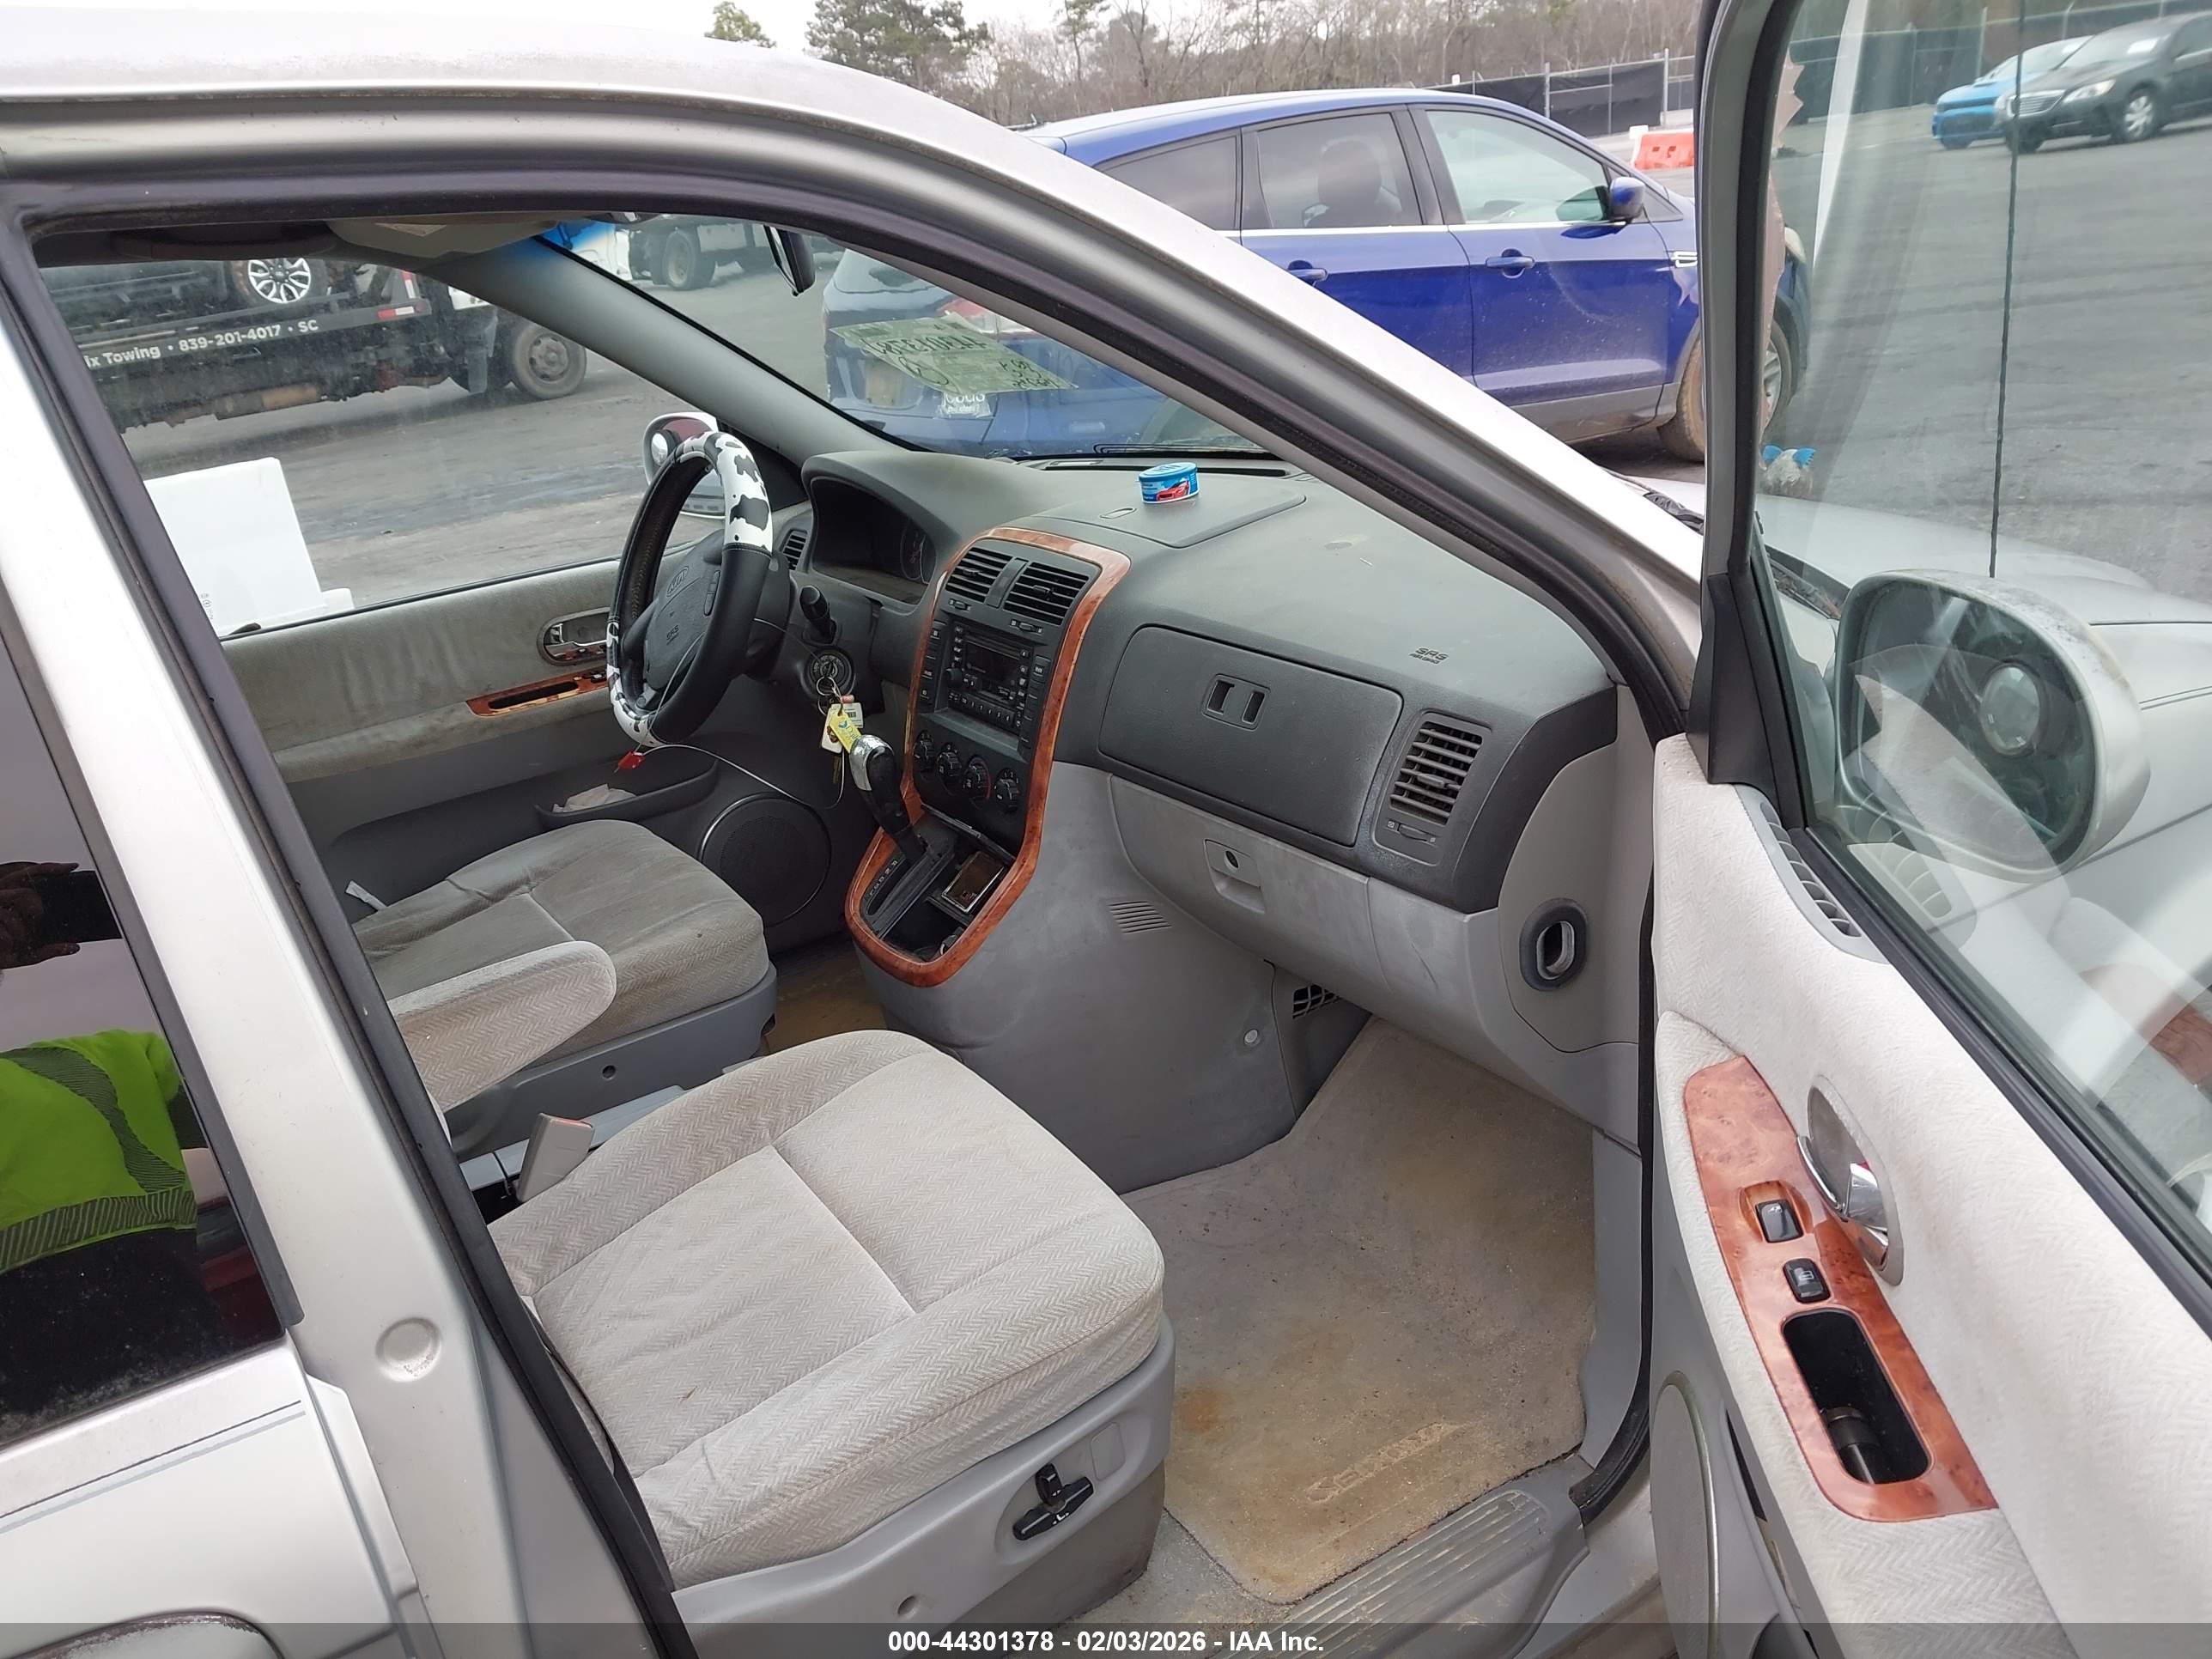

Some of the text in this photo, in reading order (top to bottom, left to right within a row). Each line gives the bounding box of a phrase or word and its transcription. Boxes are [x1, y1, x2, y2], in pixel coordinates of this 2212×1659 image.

[102, 345, 161, 364] Towing
[178, 324, 282, 352] 839-201-4017
[297, 319, 319, 333] SC
